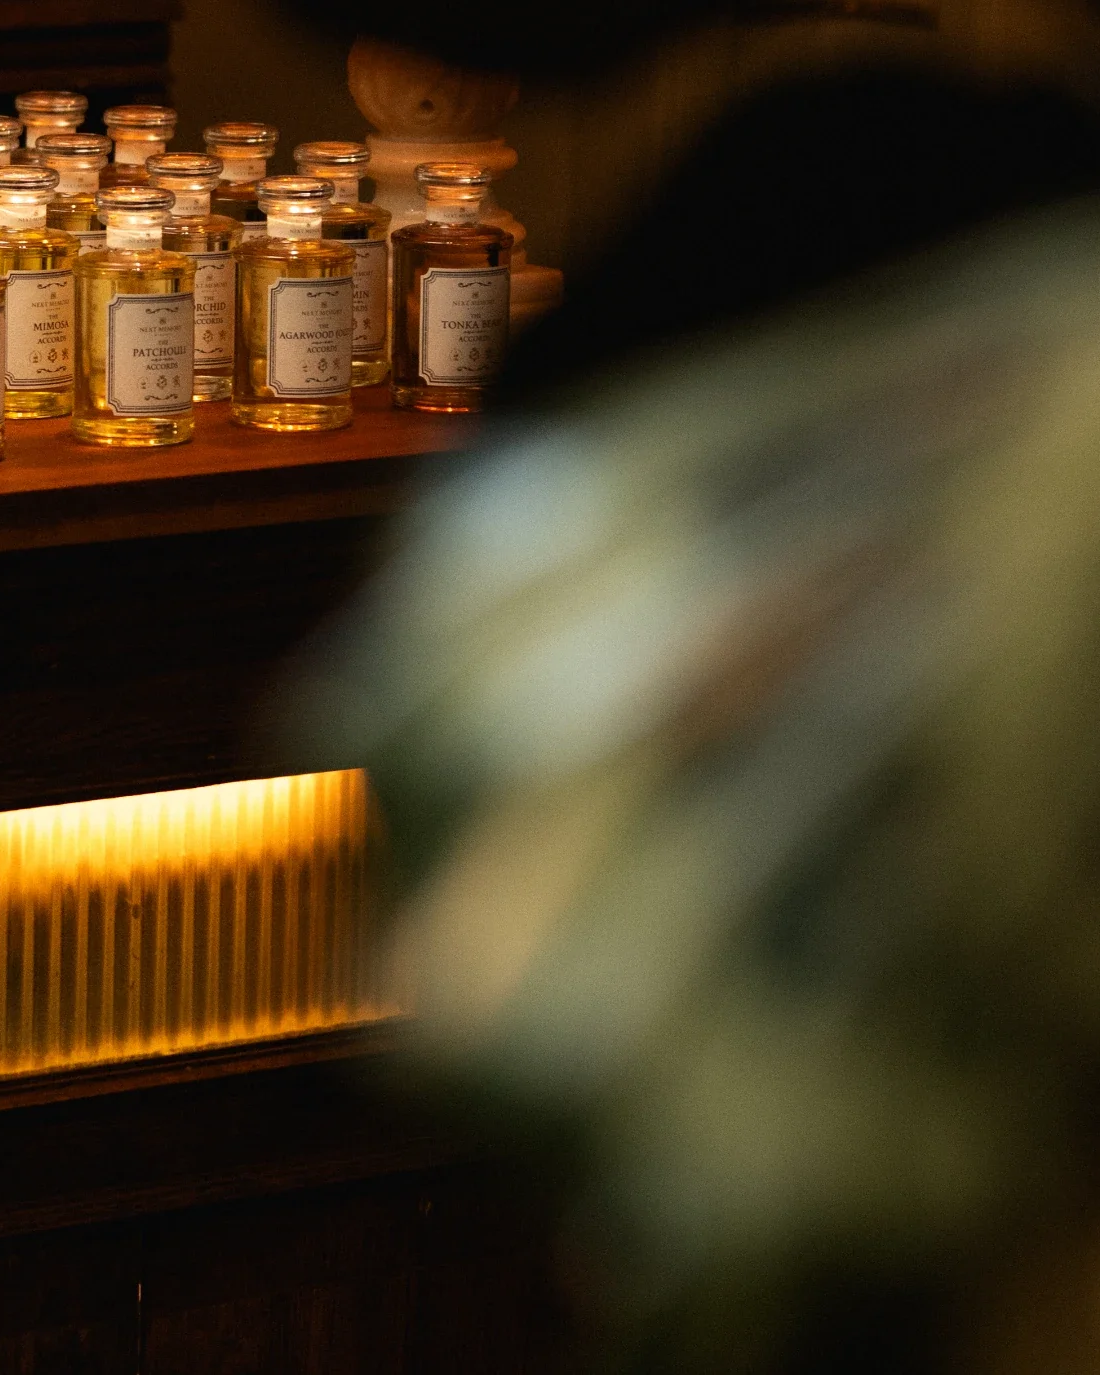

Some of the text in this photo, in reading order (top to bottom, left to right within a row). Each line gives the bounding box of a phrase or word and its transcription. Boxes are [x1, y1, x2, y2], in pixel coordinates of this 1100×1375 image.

[33, 320, 70, 332] MIMOSA
[441, 320, 479, 330] TONKA
[37, 335, 67, 345] ACCORDS
[279, 330, 334, 340] AGARWOOD
[133, 345, 187, 357] PATCHOULI
[306, 345, 338, 354] ACCORDS
[145, 362, 179, 371] ACCORDS
